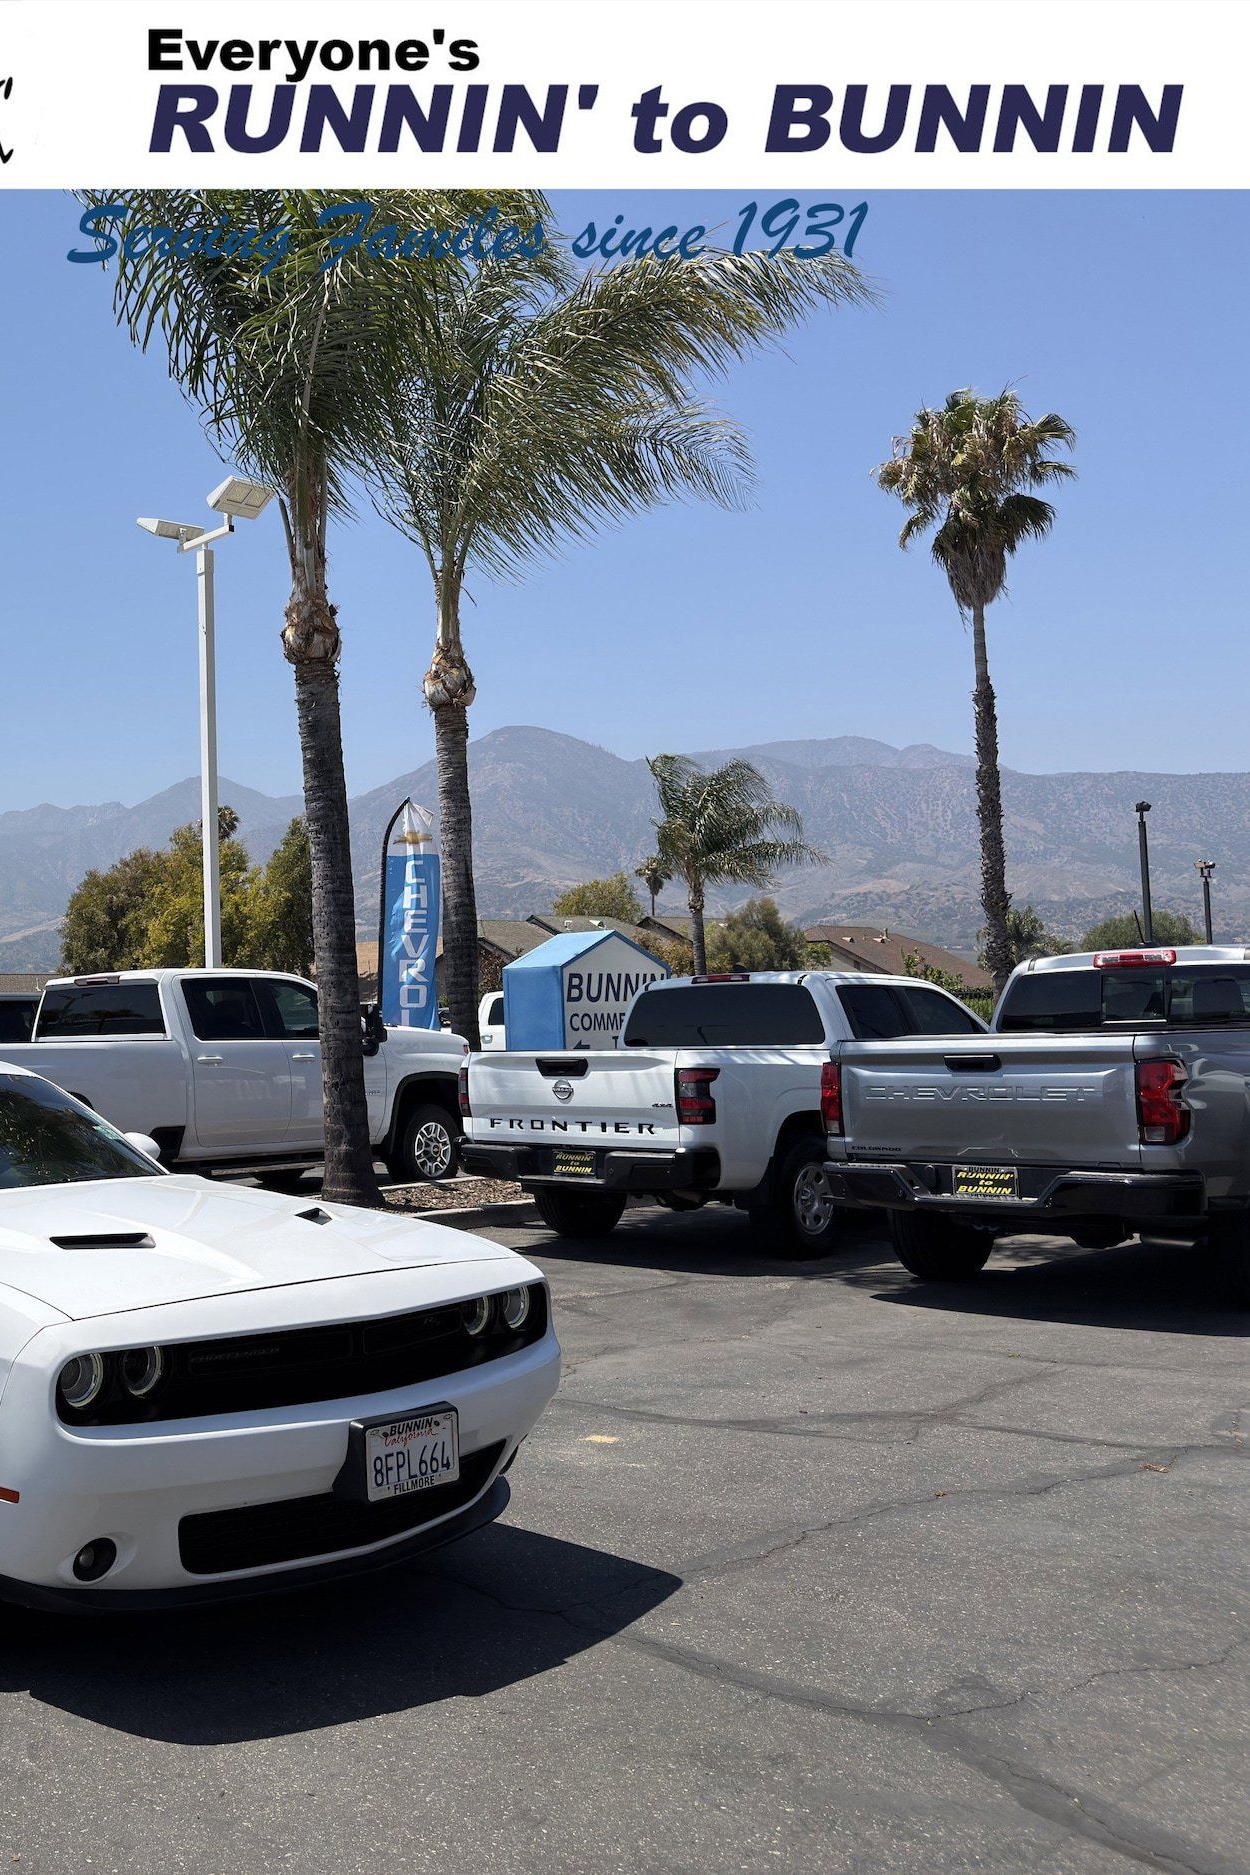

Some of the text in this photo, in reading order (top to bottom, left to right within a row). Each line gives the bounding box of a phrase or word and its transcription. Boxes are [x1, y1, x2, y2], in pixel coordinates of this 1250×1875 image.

[566, 972, 665, 1003] BUNN
[863, 1085, 1096, 1101] CHEVROLET
[489, 1118, 656, 1135] FRONTIER
[555, 1164, 593, 1174] BUNNIN
[957, 1171, 1014, 1181] RUNNIN'
[958, 1185, 1012, 1195] BUNNIN
[389, 1417, 434, 1437] BUNNIN
[373, 1441, 451, 1488] 8FPL664
[393, 1475, 436, 1495] FILLMORE
